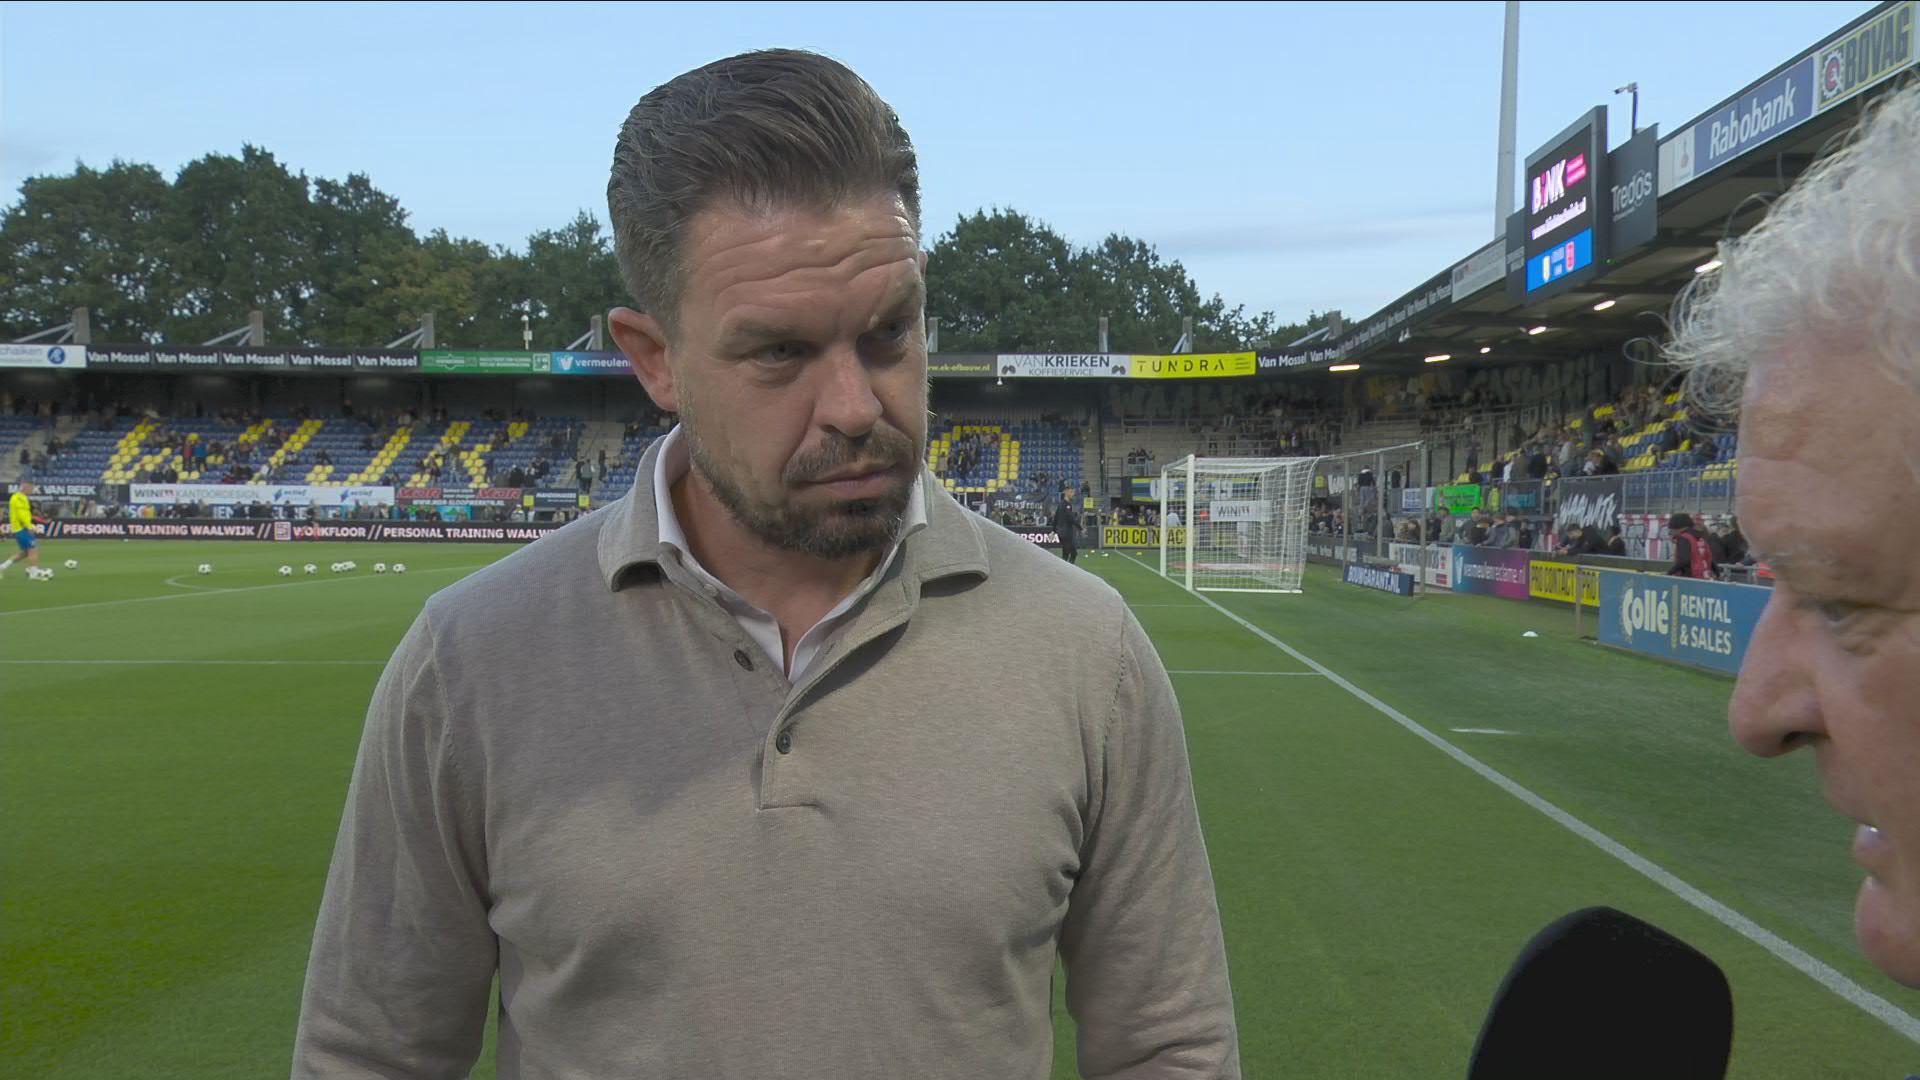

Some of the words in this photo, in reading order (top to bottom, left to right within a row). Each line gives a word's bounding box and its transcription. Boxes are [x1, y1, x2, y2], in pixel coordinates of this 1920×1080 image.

[1843, 6, 1911, 91] BOVAG
[1709, 78, 1797, 160] Rabobank
[88, 352, 110, 363] Van
[113, 352, 150, 363] Mossel
[156, 352, 178, 364] Van
[180, 352, 218, 364] Mossel
[224, 352, 245, 365] Van
[247, 352, 285, 365] Mossel
[291, 354, 312, 366] Van
[314, 354, 352, 366] Mossel
[357, 355, 378, 367] Van
[380, 355, 417, 367] Mossel
[1258, 357, 1277, 368] Van
[1279, 352, 1308, 367] Mossel
[1310, 350, 1323, 362] Van
[576, 358, 633, 370] vermeulen
[1136, 359, 1225, 373] TUNDRA
[1029, 368, 1094, 376] KOFFIESERVICE
[43, 485, 65, 495] VAN
[67, 485, 96, 495] BEEK
[63, 524, 126, 536] PERSONAL
[127, 524, 189, 536] TRAINING
[190, 525, 255, 537] WAALWIJK
[384, 527, 443, 538] PERSONAL
[446, 528, 504, 539] TRAINING
[507, 529, 553, 539] WAALW
[1105, 528, 1129, 545] PRO
[1622, 586, 1669, 636] Collé
[1680, 594, 1732, 624] RENTAL
[1680, 624, 1689, 647] &
[1690, 625, 1732, 655] SALES
